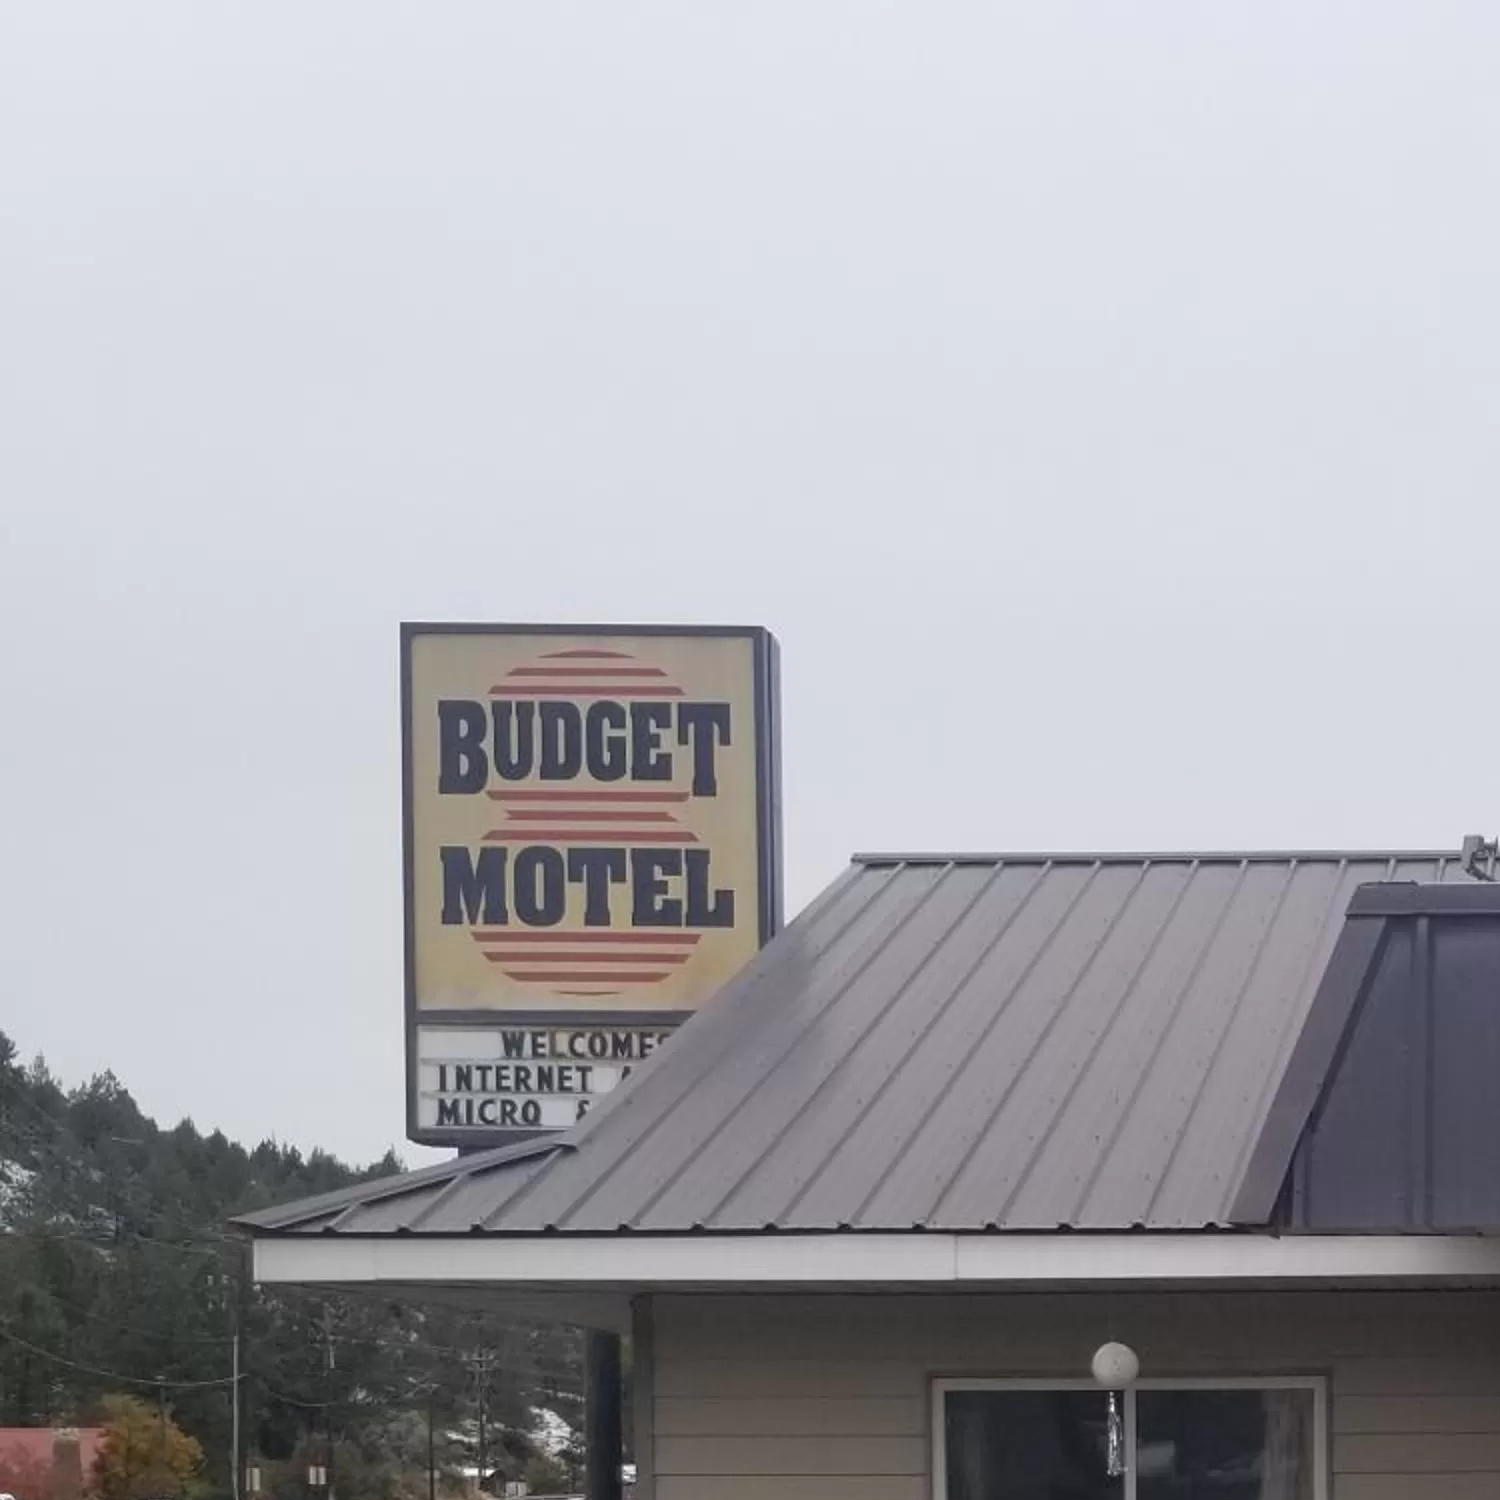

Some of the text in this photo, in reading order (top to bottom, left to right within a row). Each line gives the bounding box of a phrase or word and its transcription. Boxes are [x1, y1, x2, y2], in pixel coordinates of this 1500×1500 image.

[438, 700, 732, 797] BUDGET
[439, 846, 735, 928] MOTEL
[438, 1065, 593, 1093] INTERNET
[435, 1099, 542, 1127] MICRO
